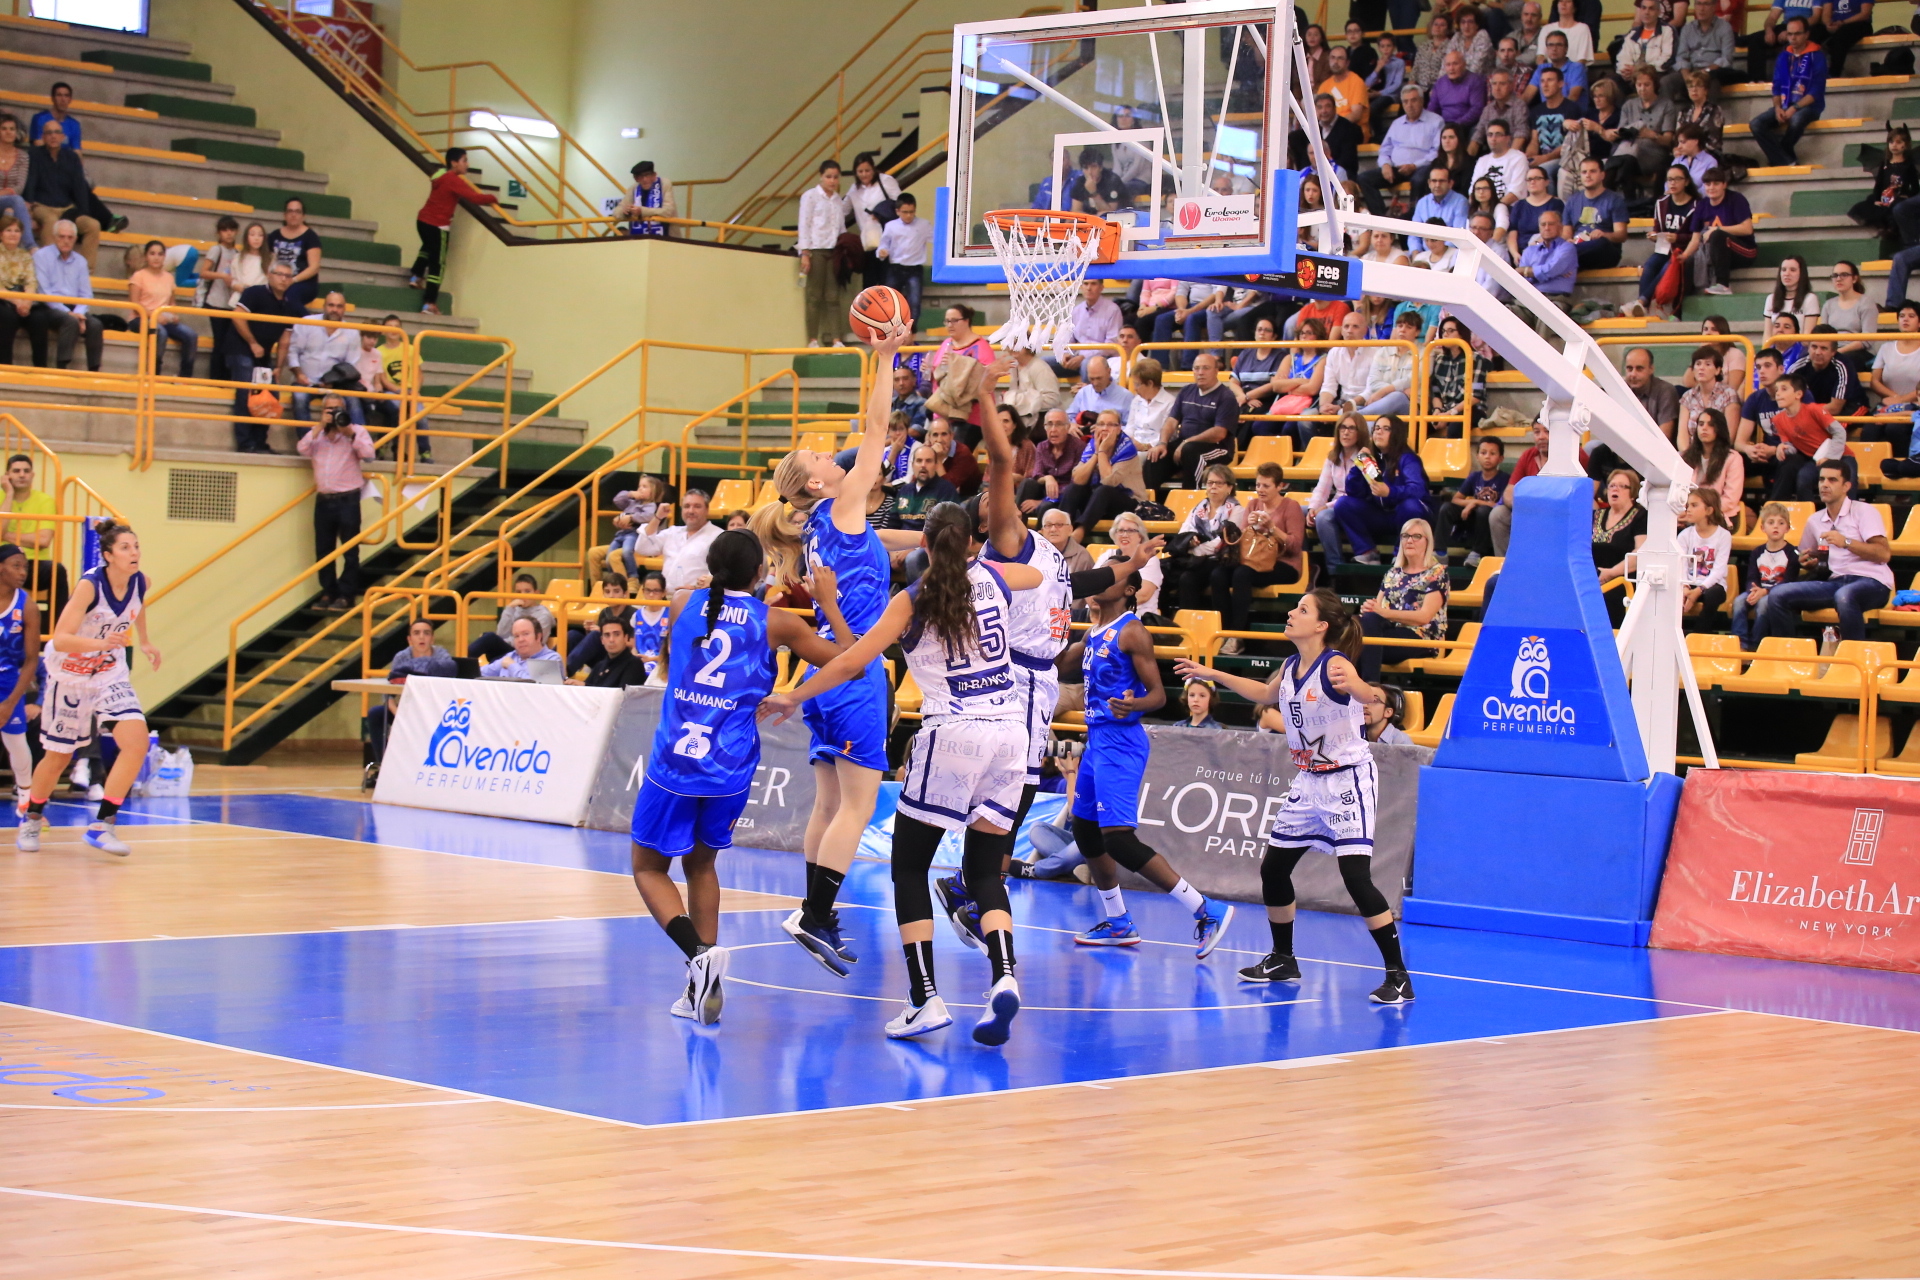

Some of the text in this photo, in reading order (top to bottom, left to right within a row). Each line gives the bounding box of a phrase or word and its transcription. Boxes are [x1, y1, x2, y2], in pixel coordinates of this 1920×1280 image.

[1204, 206, 1250, 218] EuroLeague
[1354, 597, 1360, 605] 3
[700, 601, 749, 625] EONU
[694, 628, 732, 689] 2
[1264, 660, 1271, 668] 2
[673, 687, 738, 711] SALAMANCA
[1289, 701, 1304, 729] 5
[1483, 721, 1576, 736] PERFUMERÍAS
[415, 771, 545, 795] PERFUMERÍAS
[1195, 765, 1243, 783] Porque
[1249, 771, 1263, 785] tú
[1267, 773, 1280, 786] lo
[1727, 869, 1920, 916] Elizabeth Ar
[1799, 920, 1893, 937] NEW YORK
